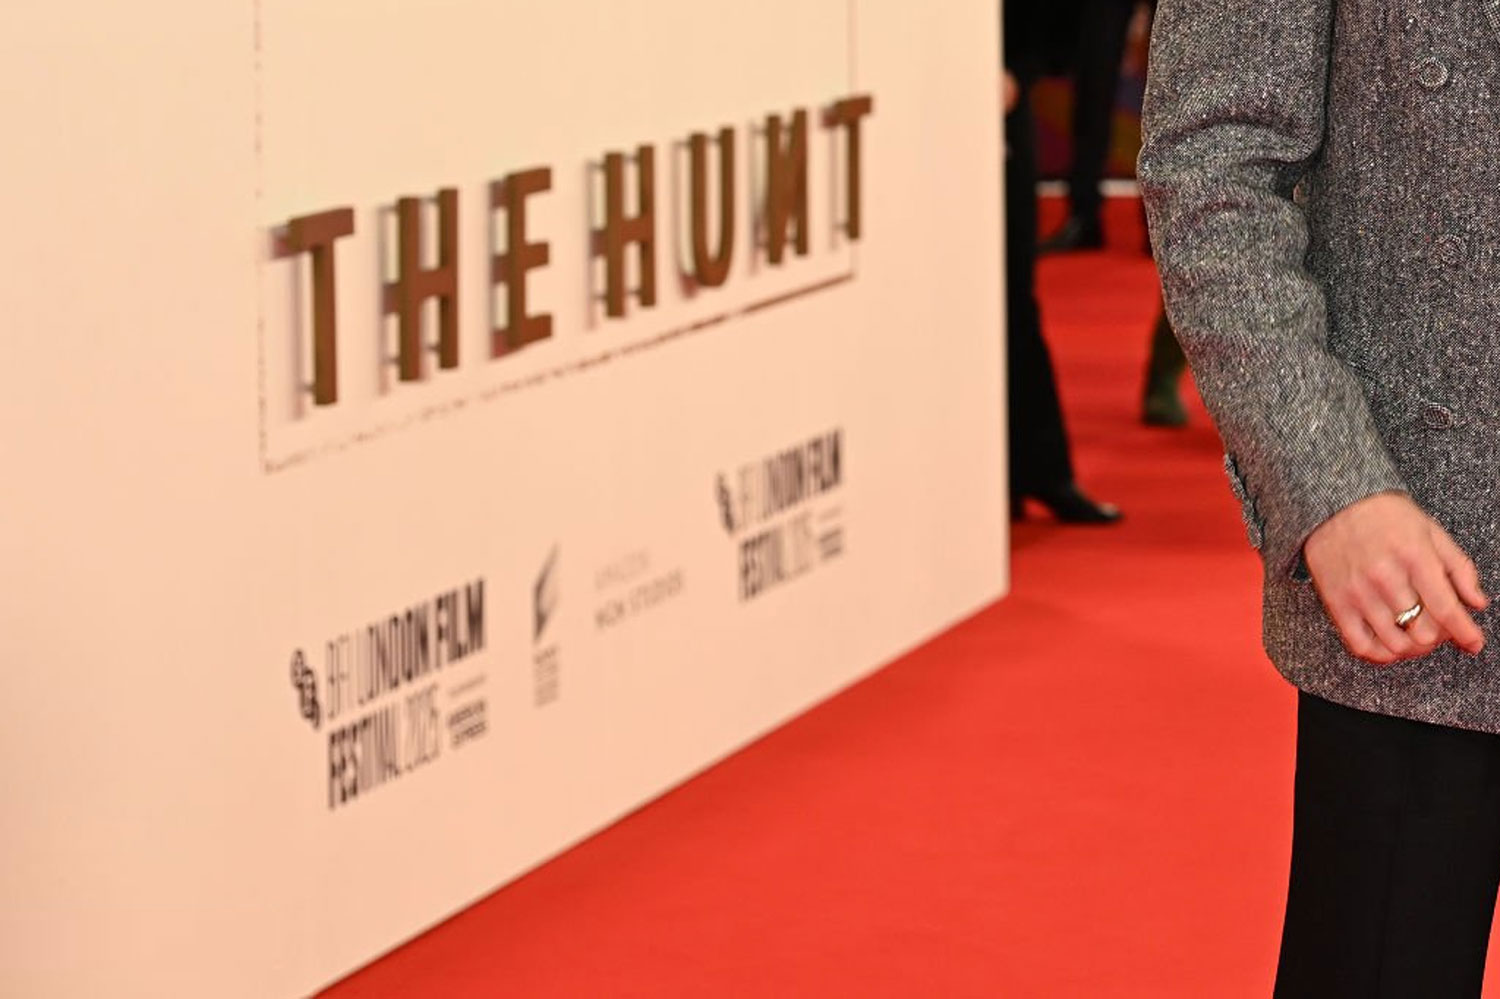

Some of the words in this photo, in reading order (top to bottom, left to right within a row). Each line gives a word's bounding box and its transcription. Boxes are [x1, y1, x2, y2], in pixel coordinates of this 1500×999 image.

[270, 165, 553, 408] THE
[588, 94, 873, 322] HUNT
[807, 427, 842, 497] FILM
[327, 634, 352, 719] BFI
[356, 601, 431, 704] LONDON
[434, 578, 484, 669] FILM
[328, 703, 400, 810] FESTIVAL
